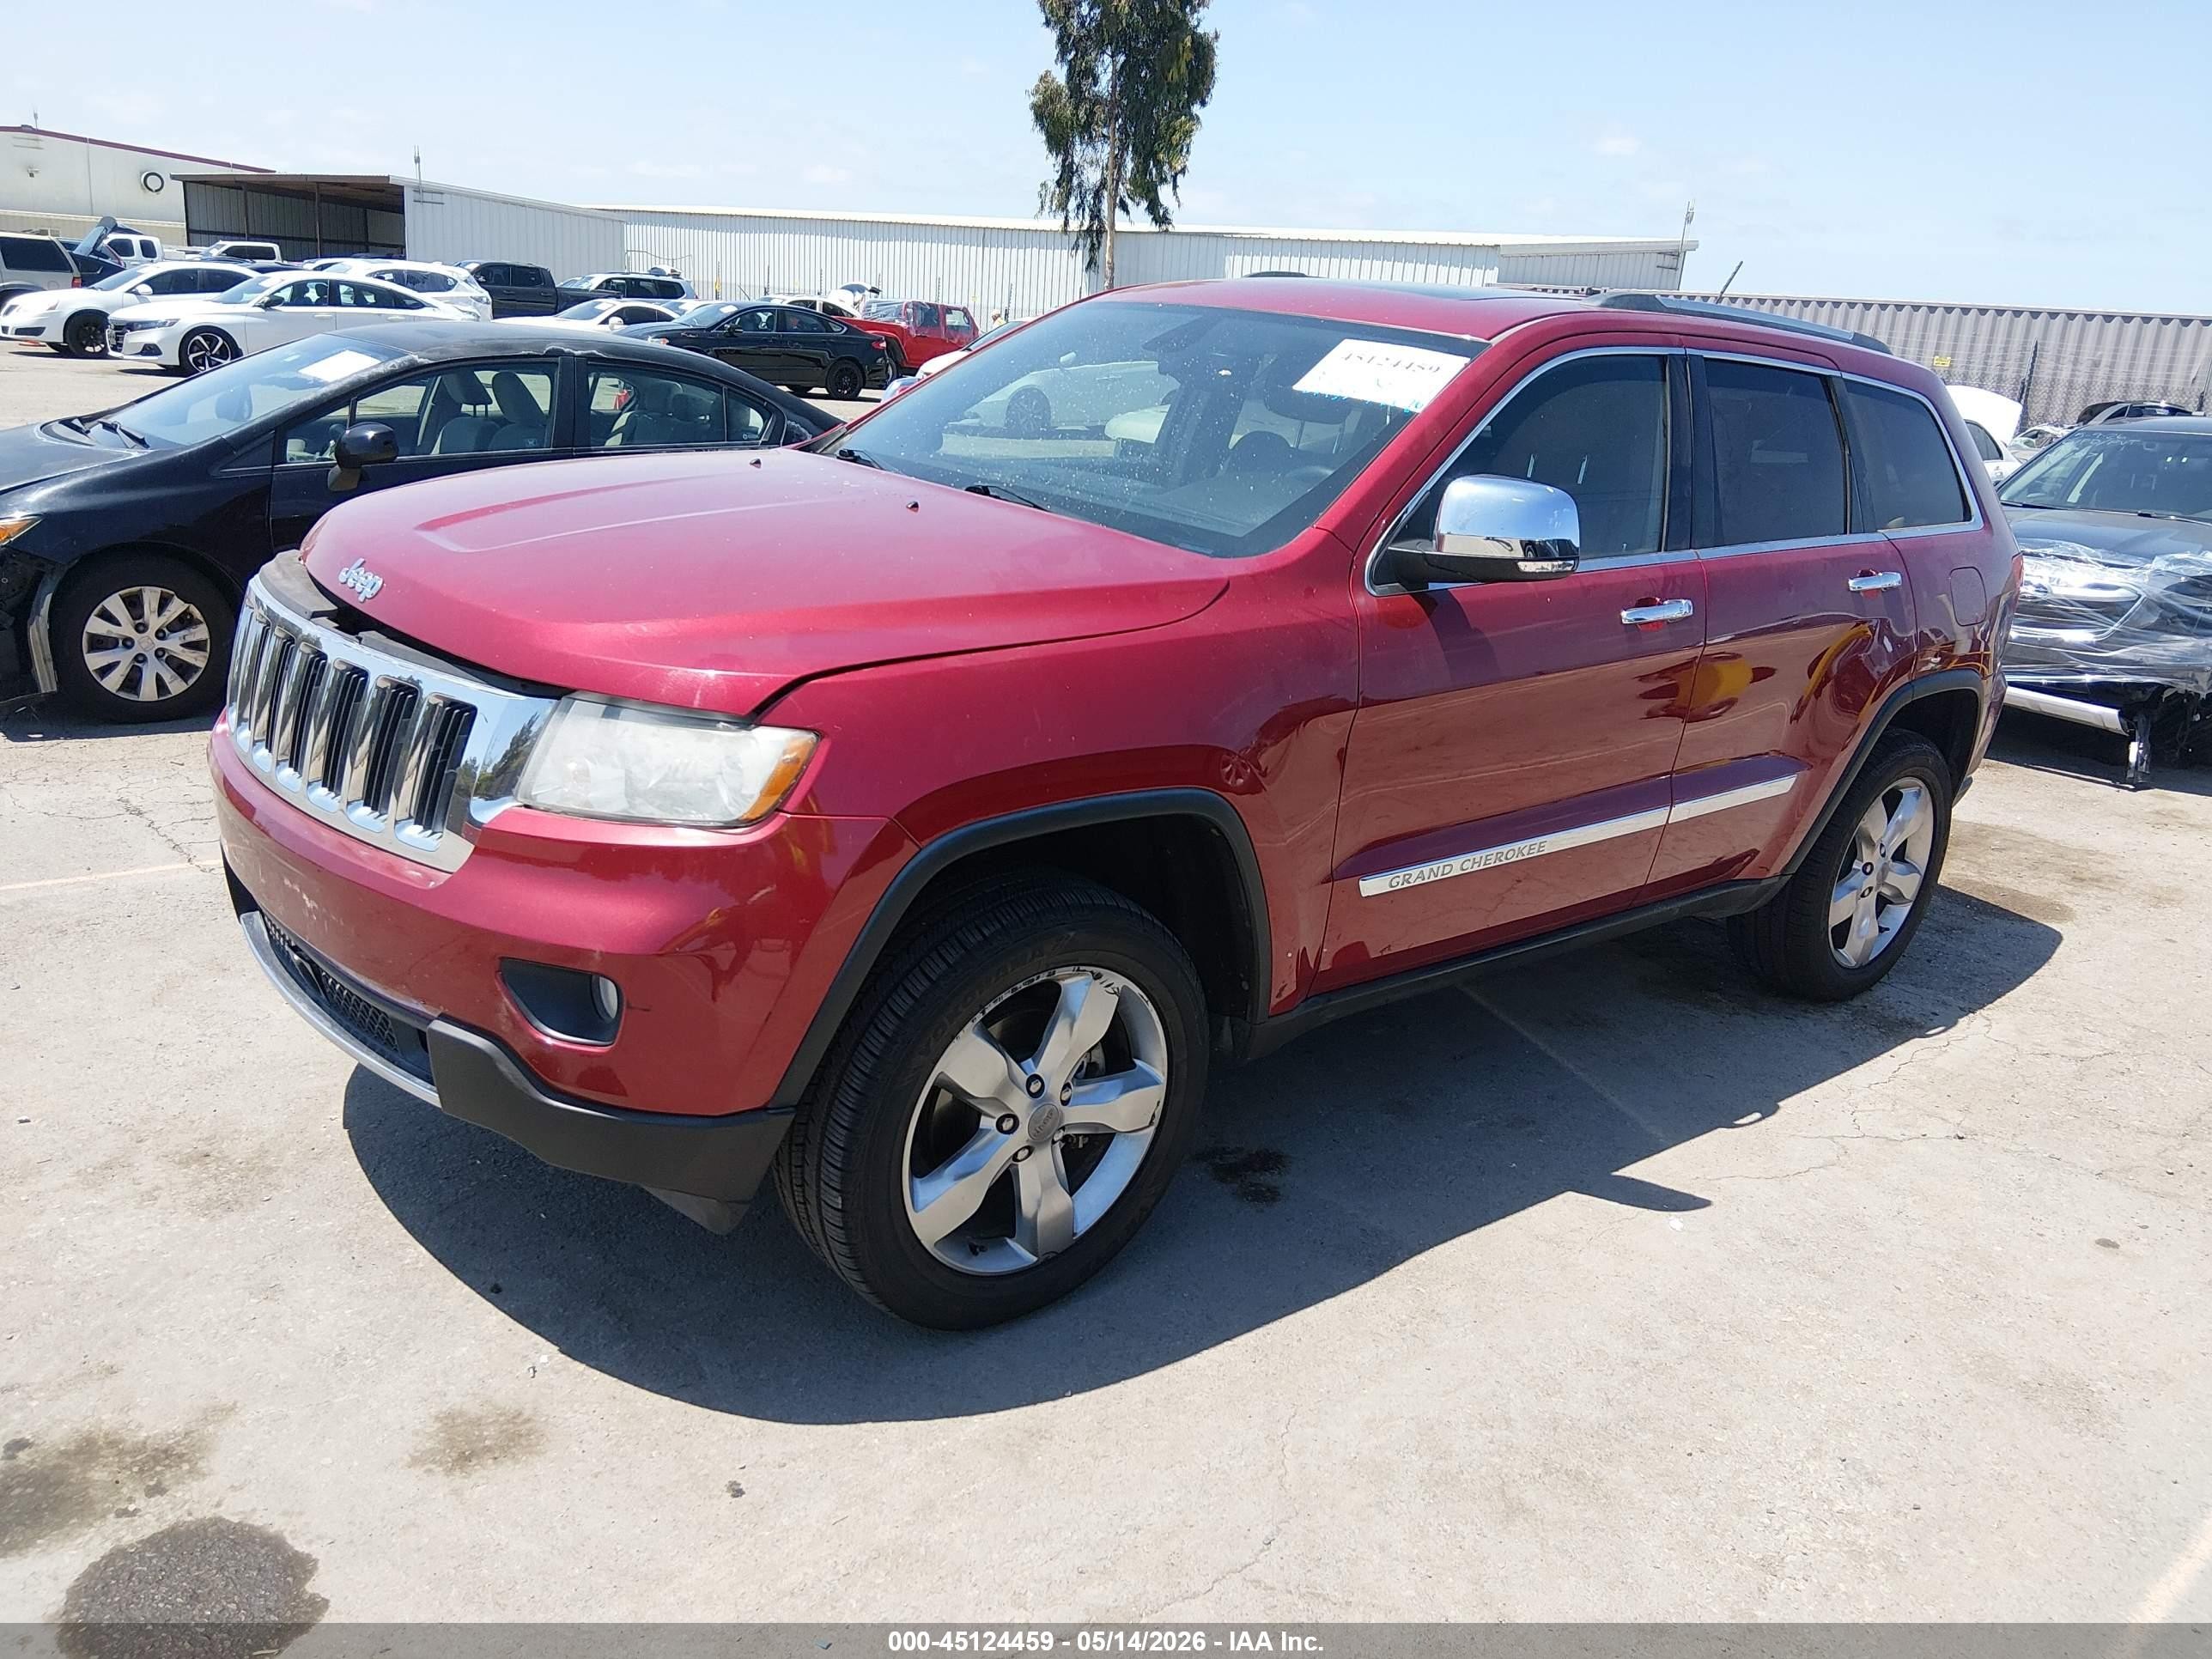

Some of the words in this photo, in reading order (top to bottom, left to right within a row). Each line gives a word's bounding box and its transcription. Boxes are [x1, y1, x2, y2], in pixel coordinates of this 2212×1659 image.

[338, 557, 383, 602] Jeep
[1388, 863, 1454, 889] GRAND
[1460, 840, 1547, 872] CHEROKEE
